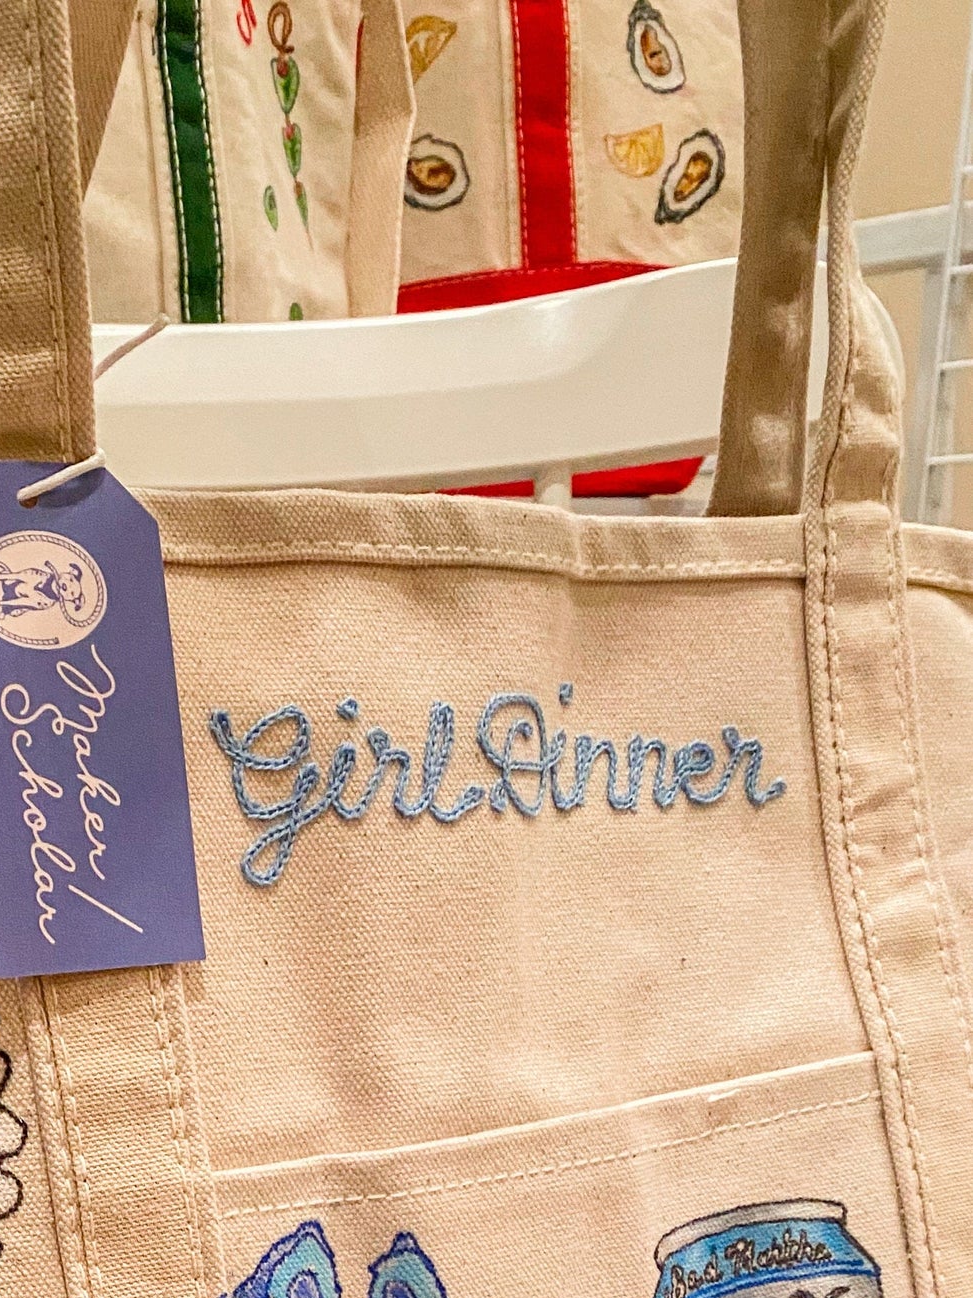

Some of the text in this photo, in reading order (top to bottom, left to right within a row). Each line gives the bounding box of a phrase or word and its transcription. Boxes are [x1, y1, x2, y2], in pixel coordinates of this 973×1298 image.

[1, 684, 75, 945] Scholar
[210, 682, 785, 887] Girl Dinner
